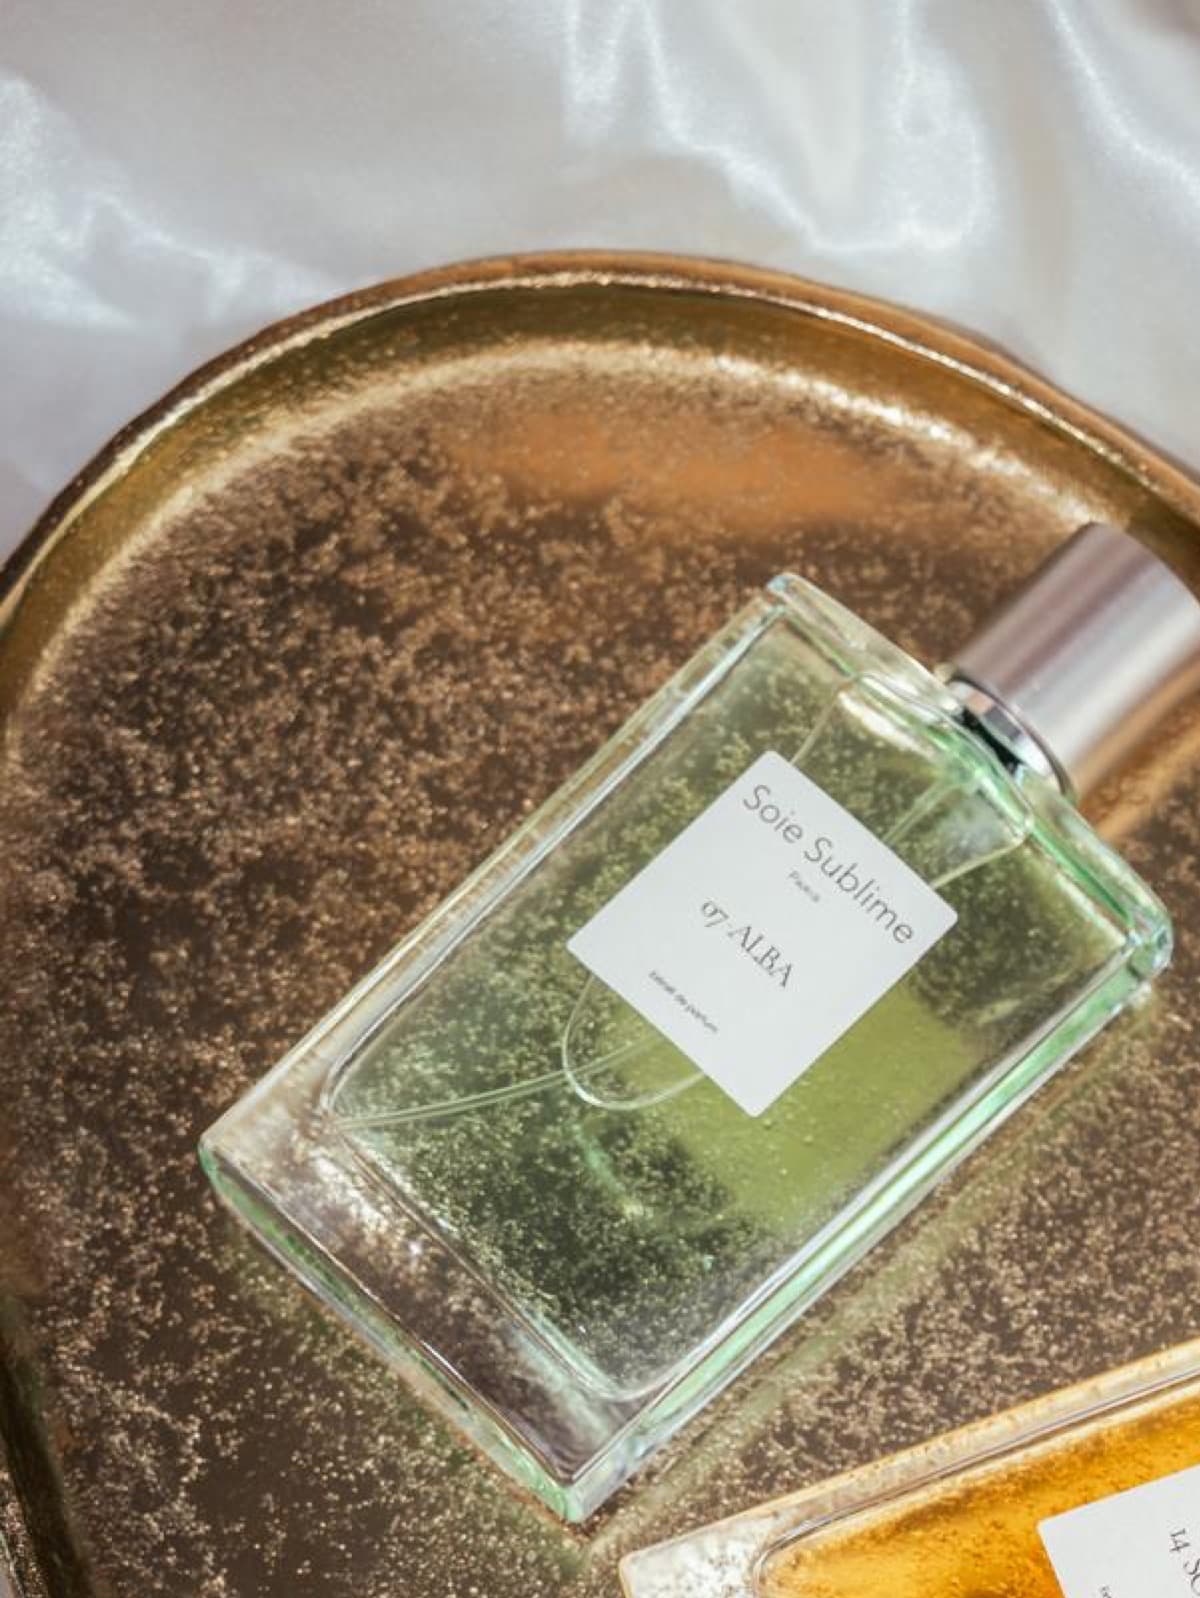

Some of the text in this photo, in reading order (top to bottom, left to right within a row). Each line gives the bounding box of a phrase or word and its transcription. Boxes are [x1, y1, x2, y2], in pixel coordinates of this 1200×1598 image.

[743, 785, 914, 943] Soie Sublime
[1170, 1528, 1190, 1552] 14
